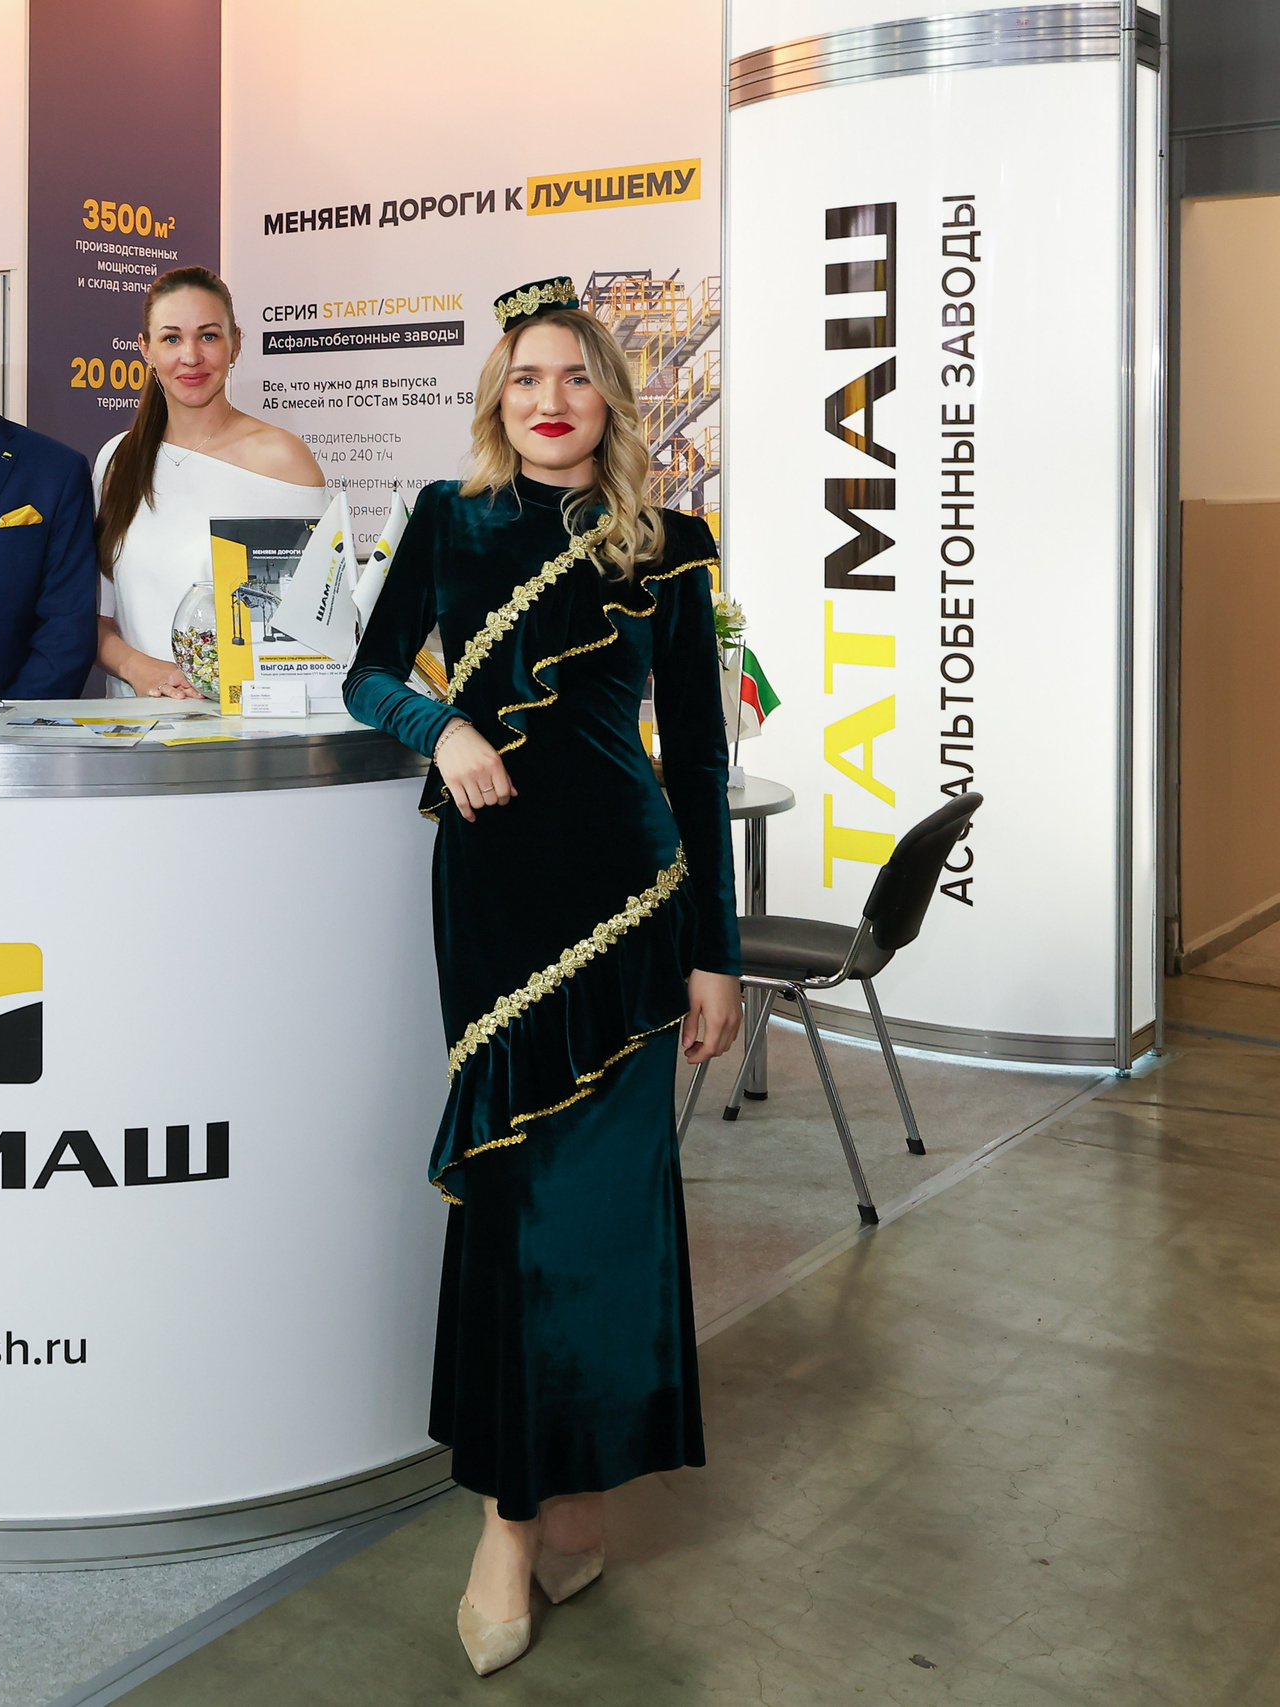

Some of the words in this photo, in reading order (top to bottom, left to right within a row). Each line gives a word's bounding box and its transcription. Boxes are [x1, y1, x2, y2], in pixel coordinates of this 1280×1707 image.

[264, 203, 372, 236] МЕНЯЕМ
[379, 190, 495, 228] ДОРОГИ
[505, 186, 523, 211] К
[531, 168, 696, 209] ЛУЧШЕМУ
[75, 239, 178, 260] производственных
[98, 260, 158, 276] мощностей
[78, 278, 85, 288] и
[88, 279, 120, 292] склад
[941, 195, 981, 387] ЗАВОДЫ
[263, 304, 318, 323] СЕРИЯ
[323, 293, 464, 319] START/SPUTNIK
[268, 330, 400, 352] Асфальтобетонные
[404, 327, 459, 345] заводы
[263, 380, 287, 393] Все,
[291, 380, 310, 391] что
[314, 380, 352, 393] нужно
[355, 379, 378, 391] для
[382, 377, 437, 390] выпуска
[263, 398, 278, 409] АБ
[282, 396, 325, 409] смесей
[328, 399, 343, 408] по
[347, 394, 398, 408] ГОСТам
[402, 393, 441, 406] 58401
[445, 395, 452, 405] и
[331, 452, 346, 463] до
[350, 449, 373, 461] 240
[376, 449, 393, 461] т/ч
[823, 202, 897, 888] ТАТМАШ
